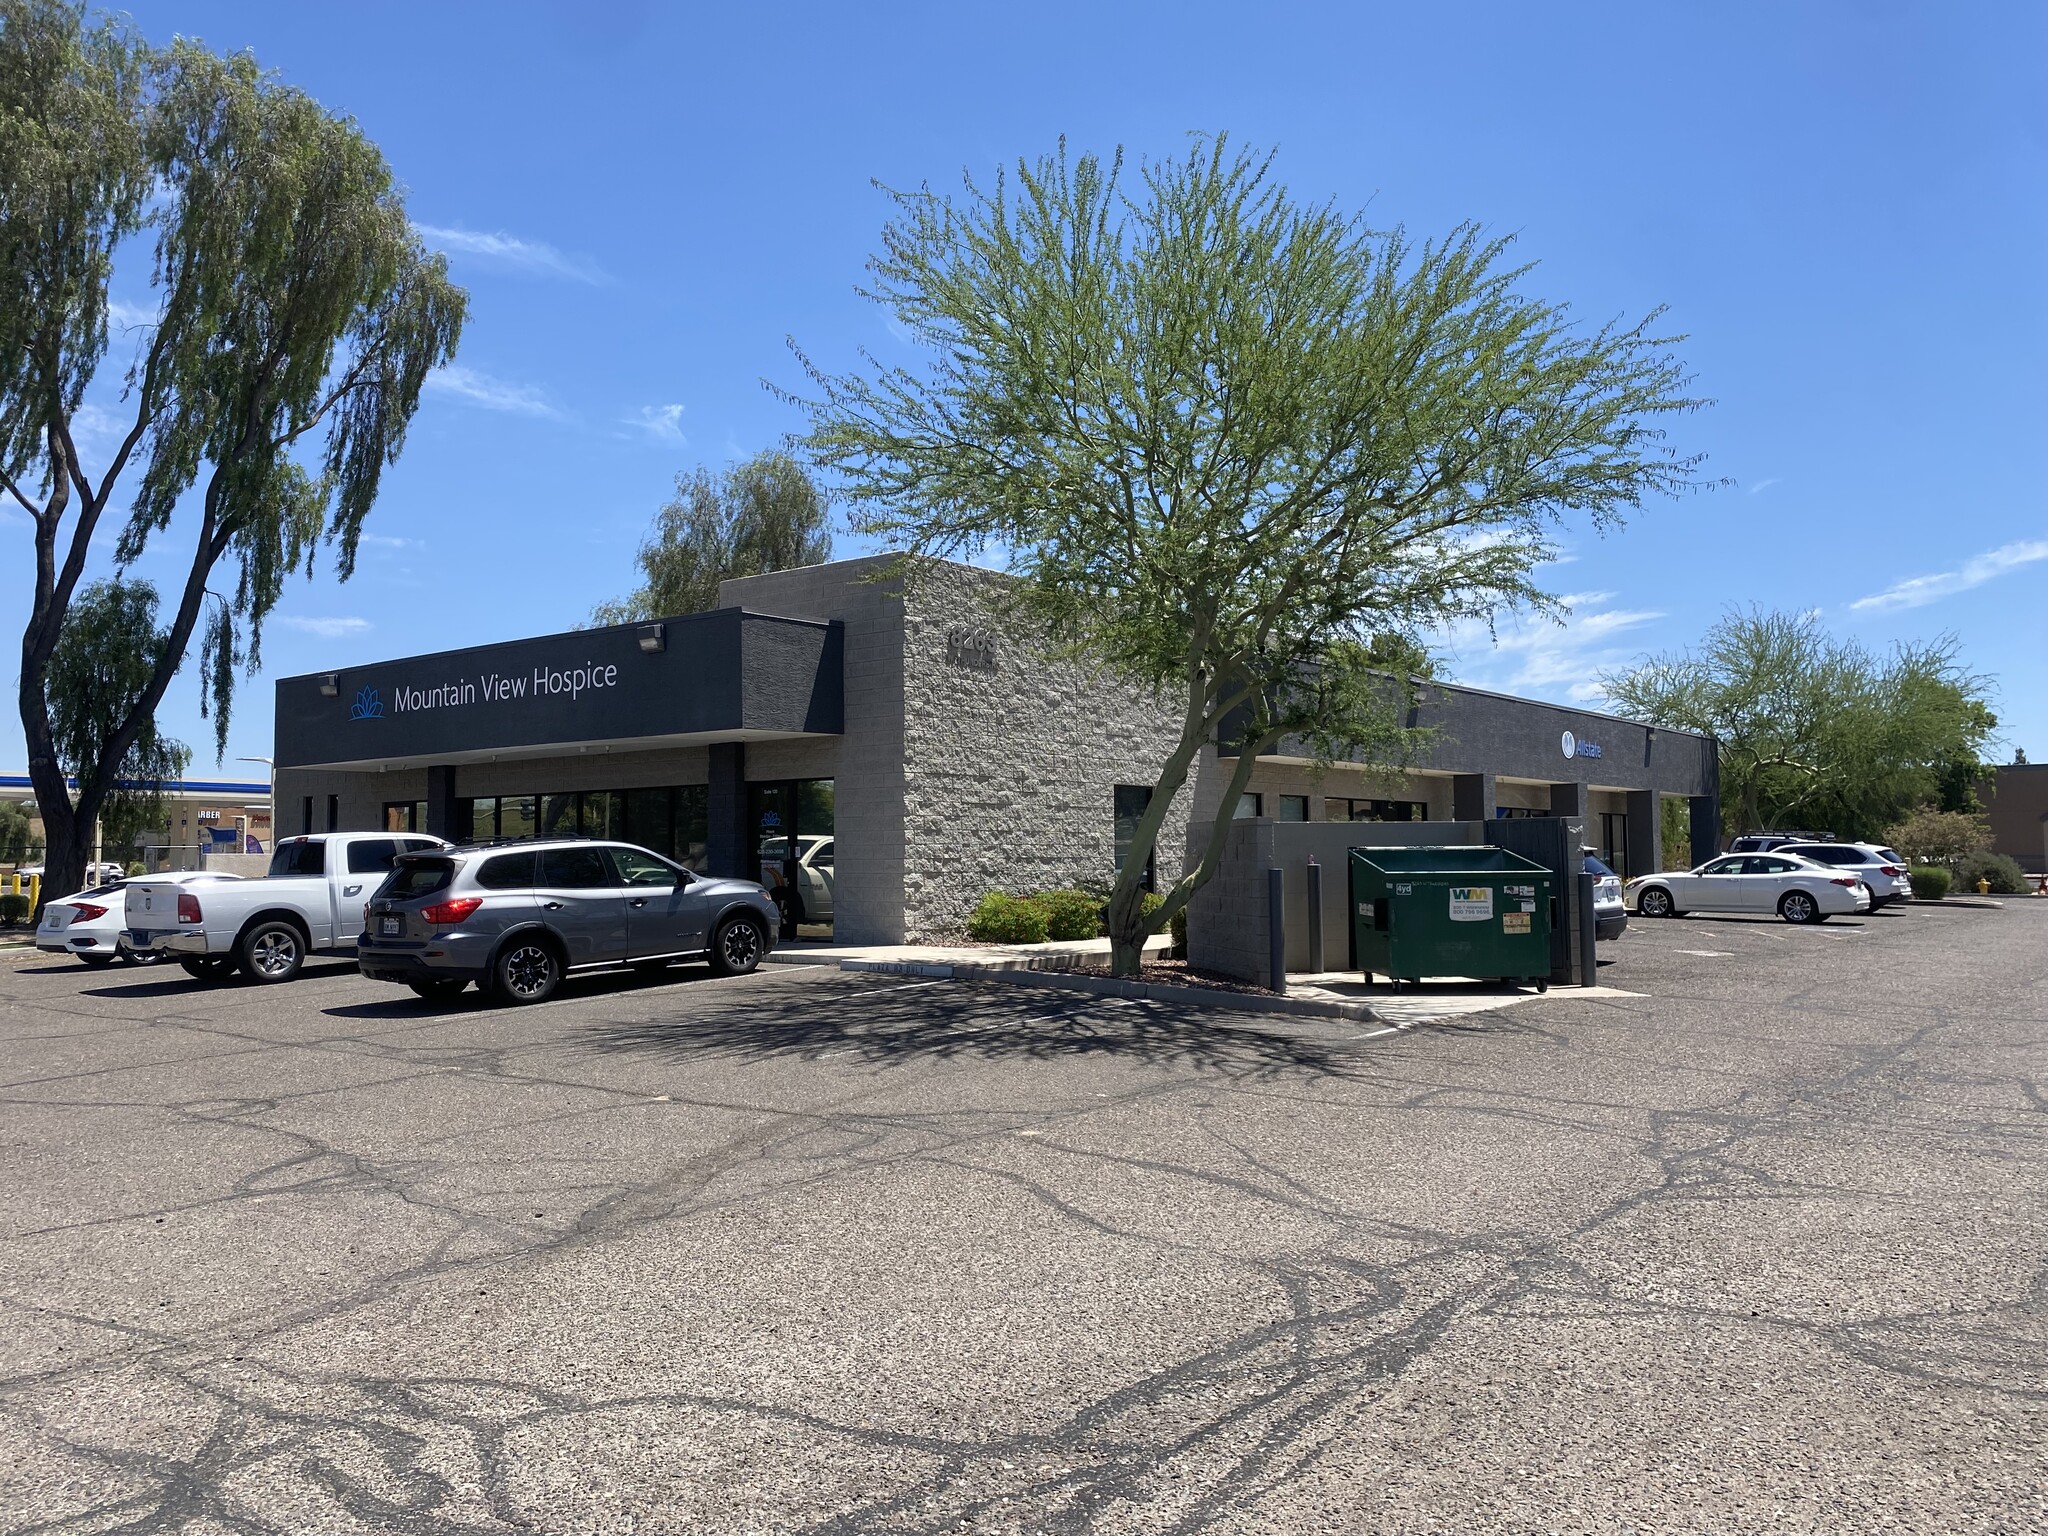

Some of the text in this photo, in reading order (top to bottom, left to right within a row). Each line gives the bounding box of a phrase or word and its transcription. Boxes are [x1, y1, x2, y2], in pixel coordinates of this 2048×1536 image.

[950, 625, 997, 653] 8263
[394, 660, 617, 713] Mountain View Hospice
[1575, 740, 1601, 758] Allstate
[1452, 889, 1488, 900] WM
